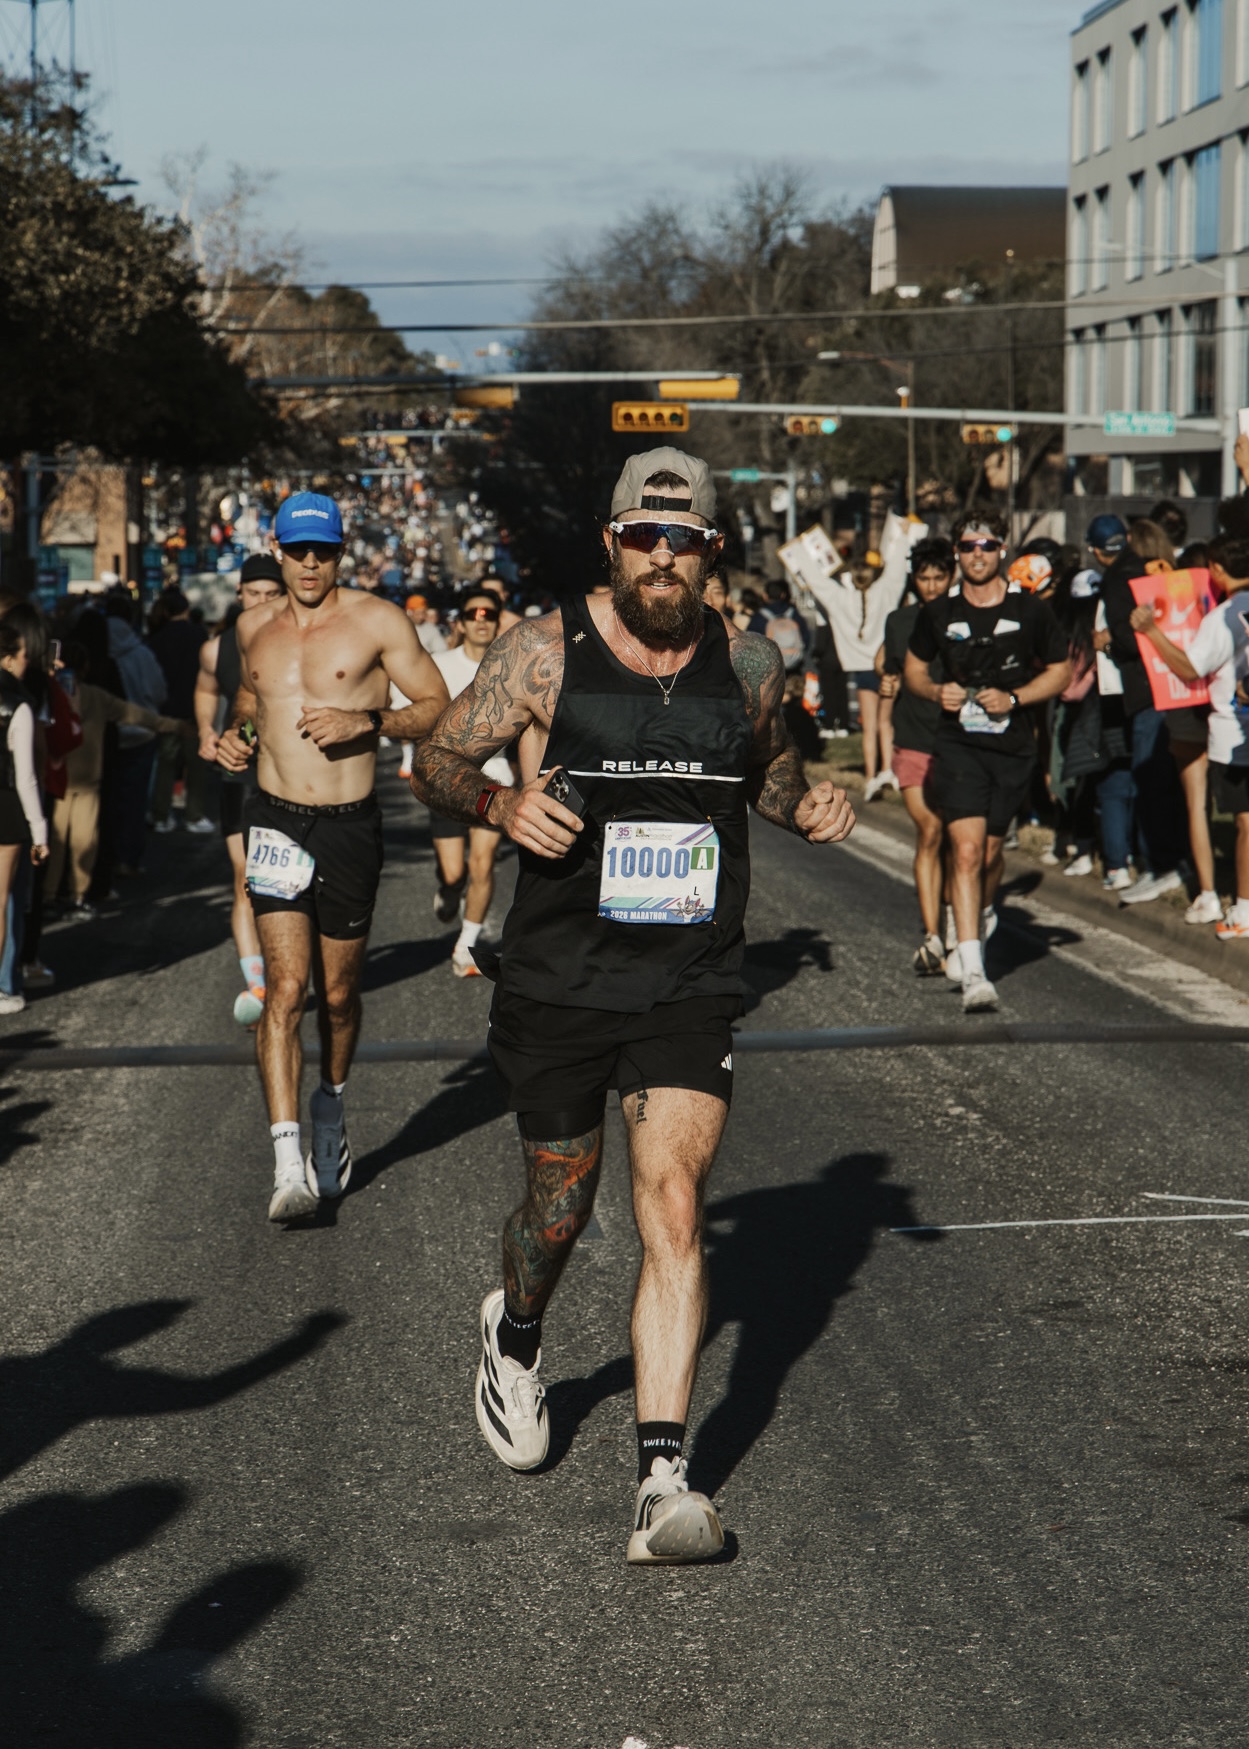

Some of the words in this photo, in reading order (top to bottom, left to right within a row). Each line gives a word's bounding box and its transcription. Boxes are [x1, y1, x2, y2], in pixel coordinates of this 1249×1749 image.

[602, 760, 703, 773] RELEASE
[269, 796, 315, 816] SPIBEL
[617, 826, 630, 837] 35
[252, 844, 291, 868] 4766
[607, 846, 690, 879] 10000
[697, 848, 708, 870] A
[694, 886, 700, 896] L
[629, 911, 668, 920] MARATHON
